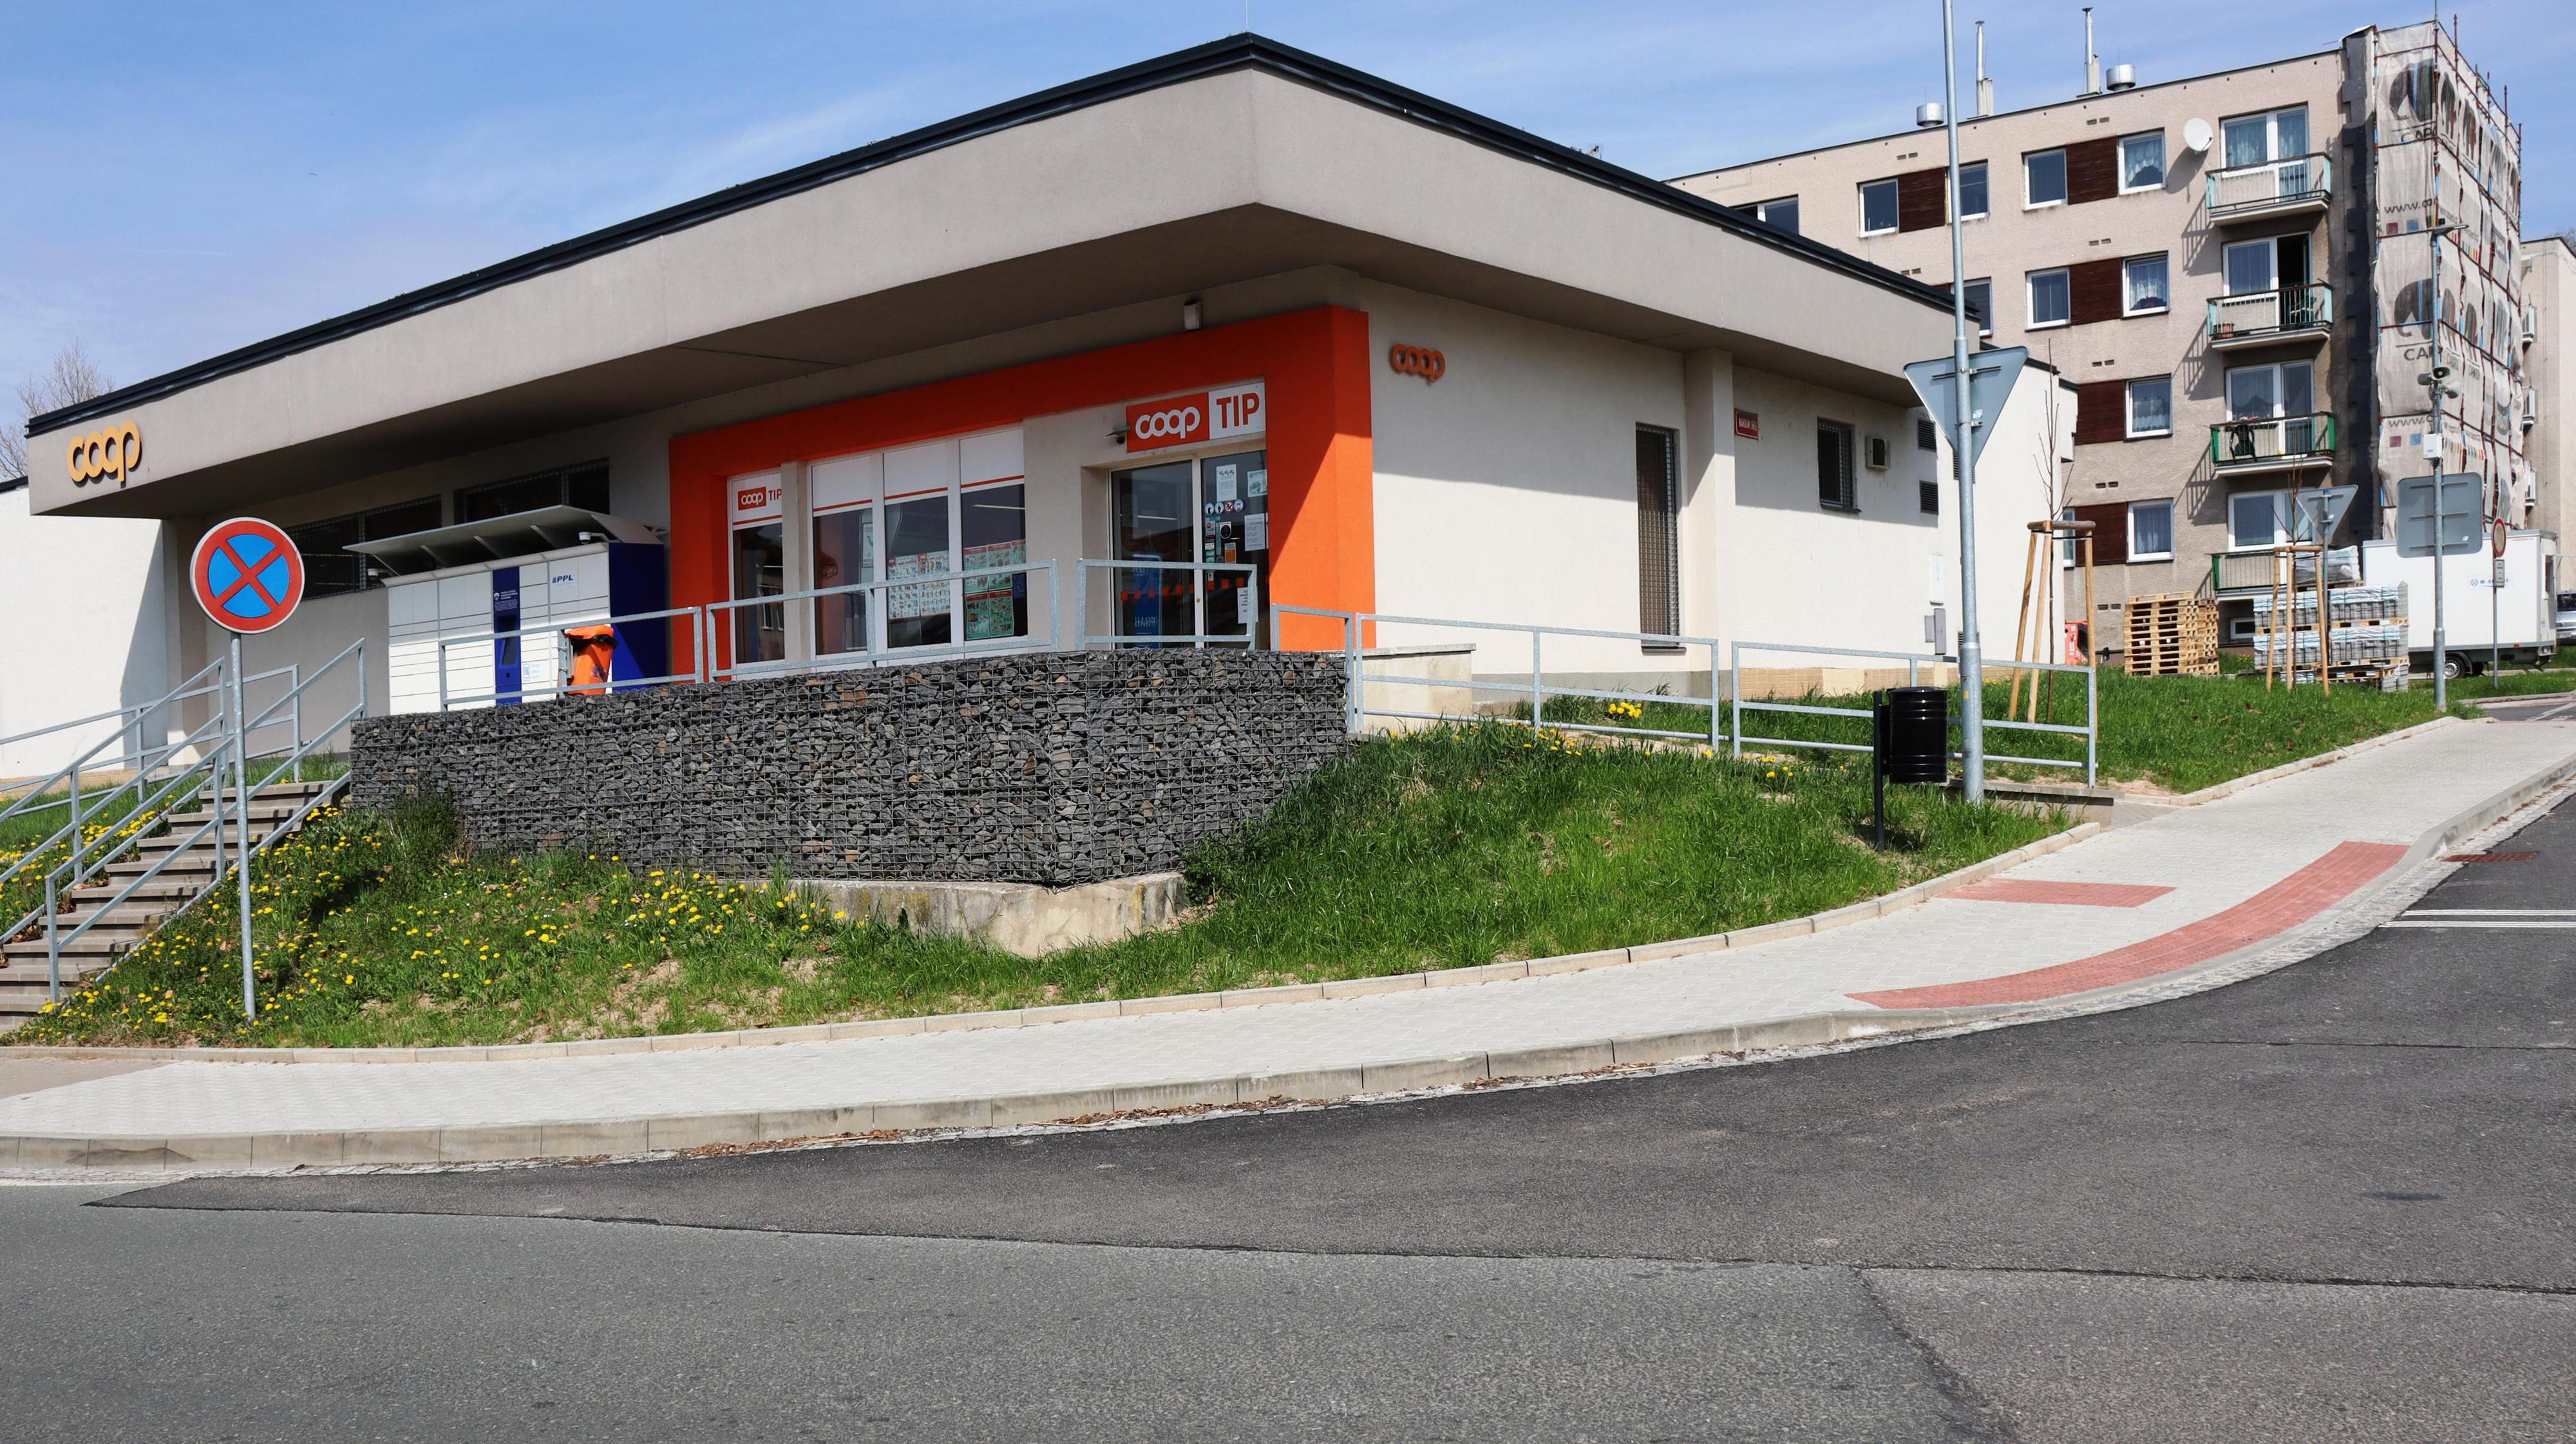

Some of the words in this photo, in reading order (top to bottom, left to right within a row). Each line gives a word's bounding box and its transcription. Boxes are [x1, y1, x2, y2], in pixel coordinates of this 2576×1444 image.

[1391, 344, 1446, 385] coop
[1135, 406, 1200, 439] coop
[1217, 392, 1260, 428] TIP
[67, 421, 141, 483] coop
[741, 492, 763, 505] coop
[768, 489, 782, 501] TIP
[556, 575, 573, 583] PPL
